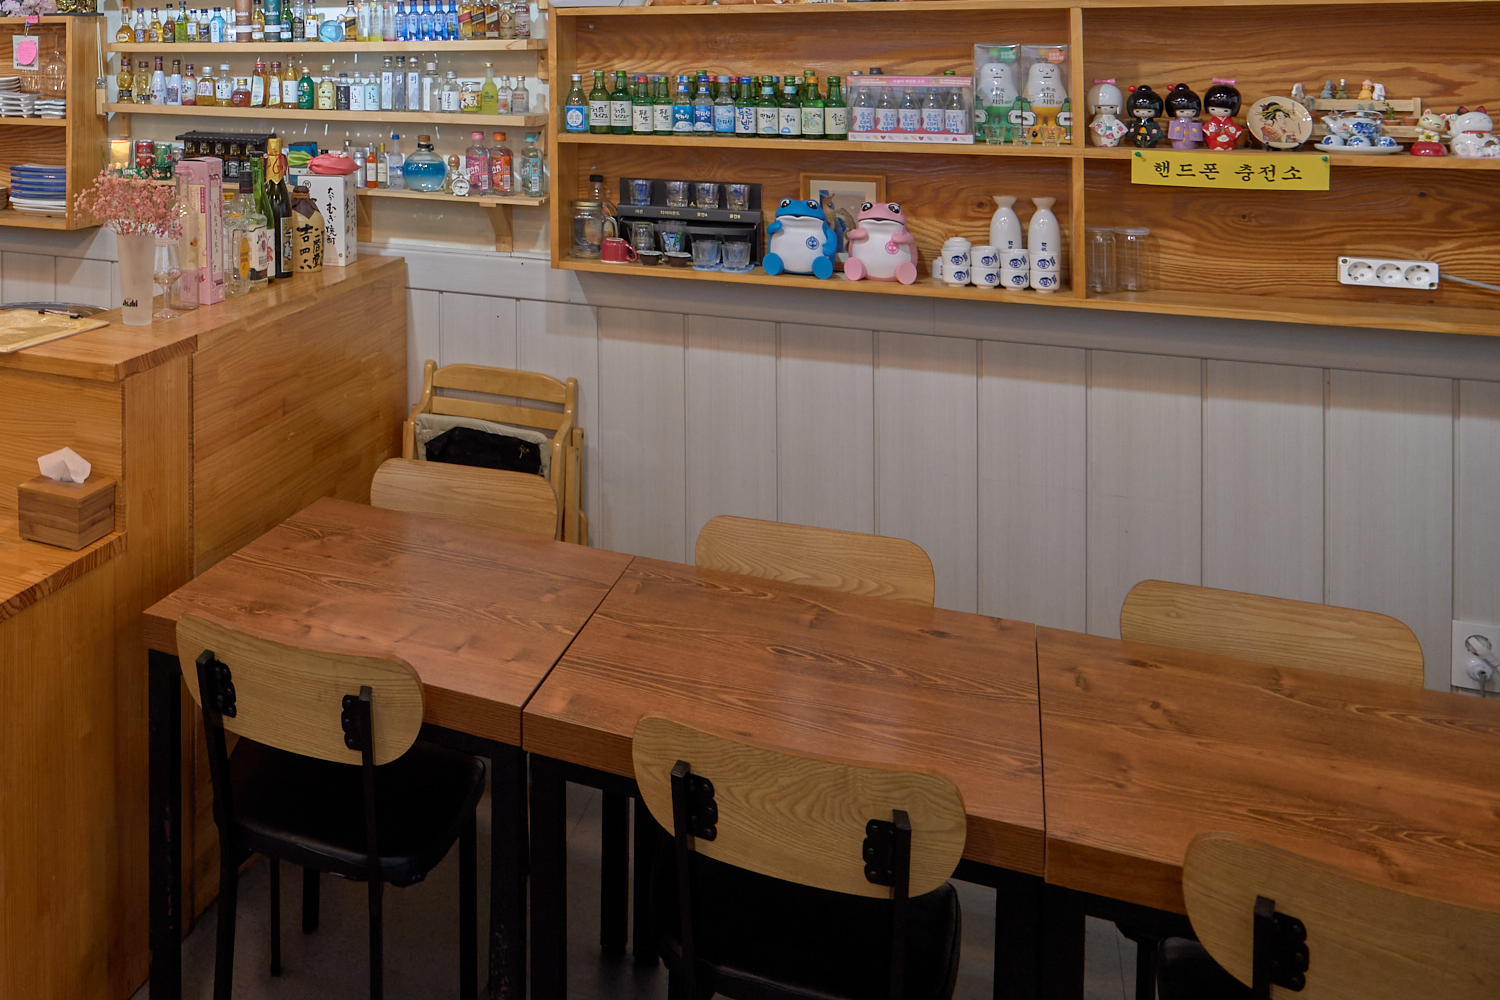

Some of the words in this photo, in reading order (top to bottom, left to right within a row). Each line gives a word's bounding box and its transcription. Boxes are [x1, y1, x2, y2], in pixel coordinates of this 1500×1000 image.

[1154, 160, 1220, 180] 핸드폰
[1234, 164, 1302, 182] 충전소
[296, 224, 314, 270] 吉四六
